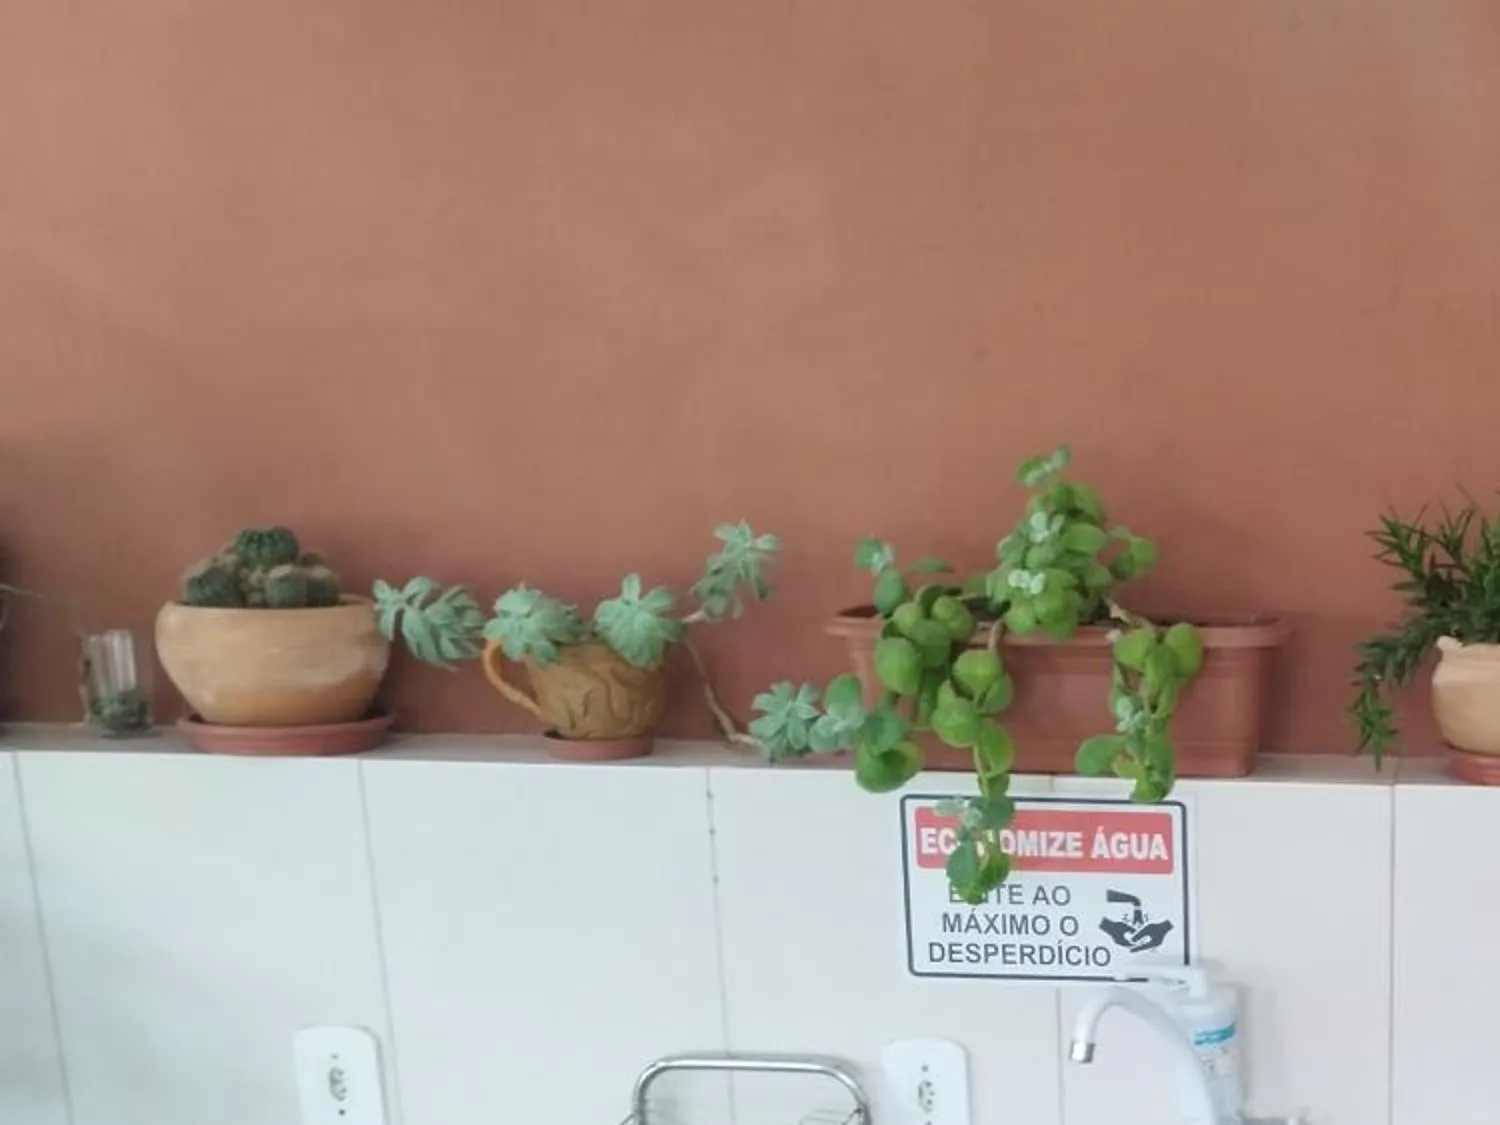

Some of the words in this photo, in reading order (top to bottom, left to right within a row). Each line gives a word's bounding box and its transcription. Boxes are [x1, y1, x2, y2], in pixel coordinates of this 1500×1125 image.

[920, 826, 1084, 858] ECOMIZE
[1090, 825, 1169, 861] ÁGUA
[949, 883, 1024, 905] EITE
[1032, 885, 1071, 906] AO
[942, 908, 1051, 936] MÁXIMO
[1059, 915, 1079, 937] O
[928, 940, 1112, 967] DESPERDÍCIO
